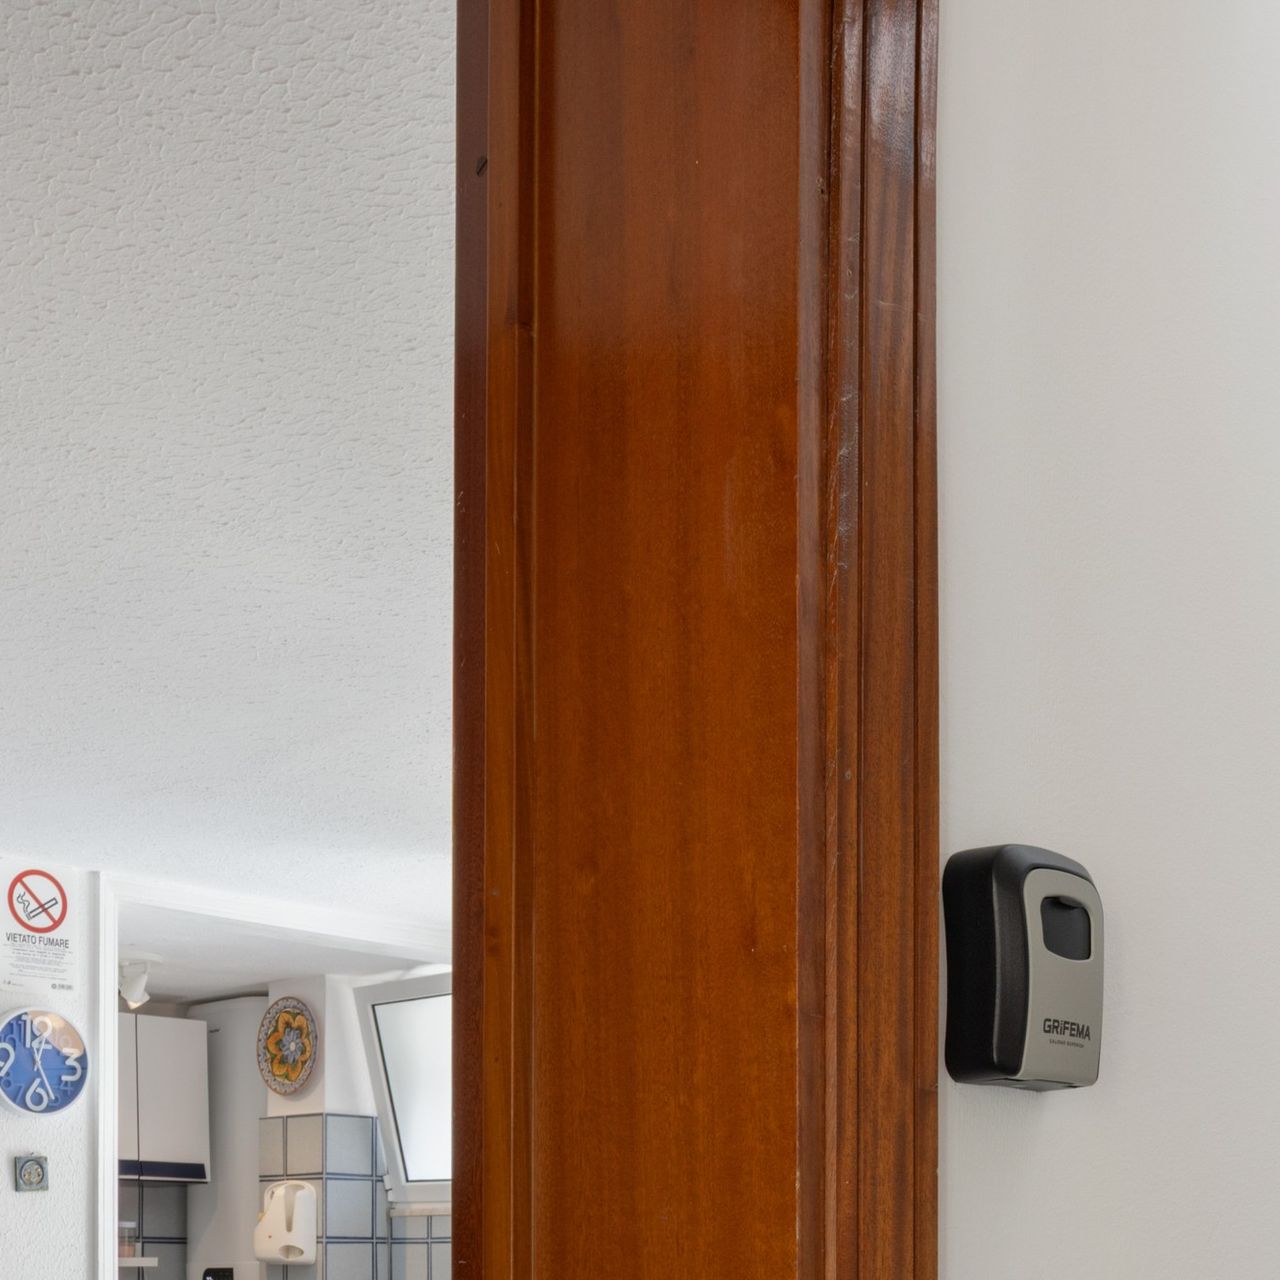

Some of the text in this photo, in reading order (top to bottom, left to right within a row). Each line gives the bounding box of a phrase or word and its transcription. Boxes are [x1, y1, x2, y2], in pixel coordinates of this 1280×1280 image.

[6, 932, 70, 949] VIETATO FUMARE
[21, 1014, 52, 1048] 12
[61, 1047, 82, 1081] 3
[14, 1083, 25, 1104] 7
[25, 1077, 49, 1112] 6
